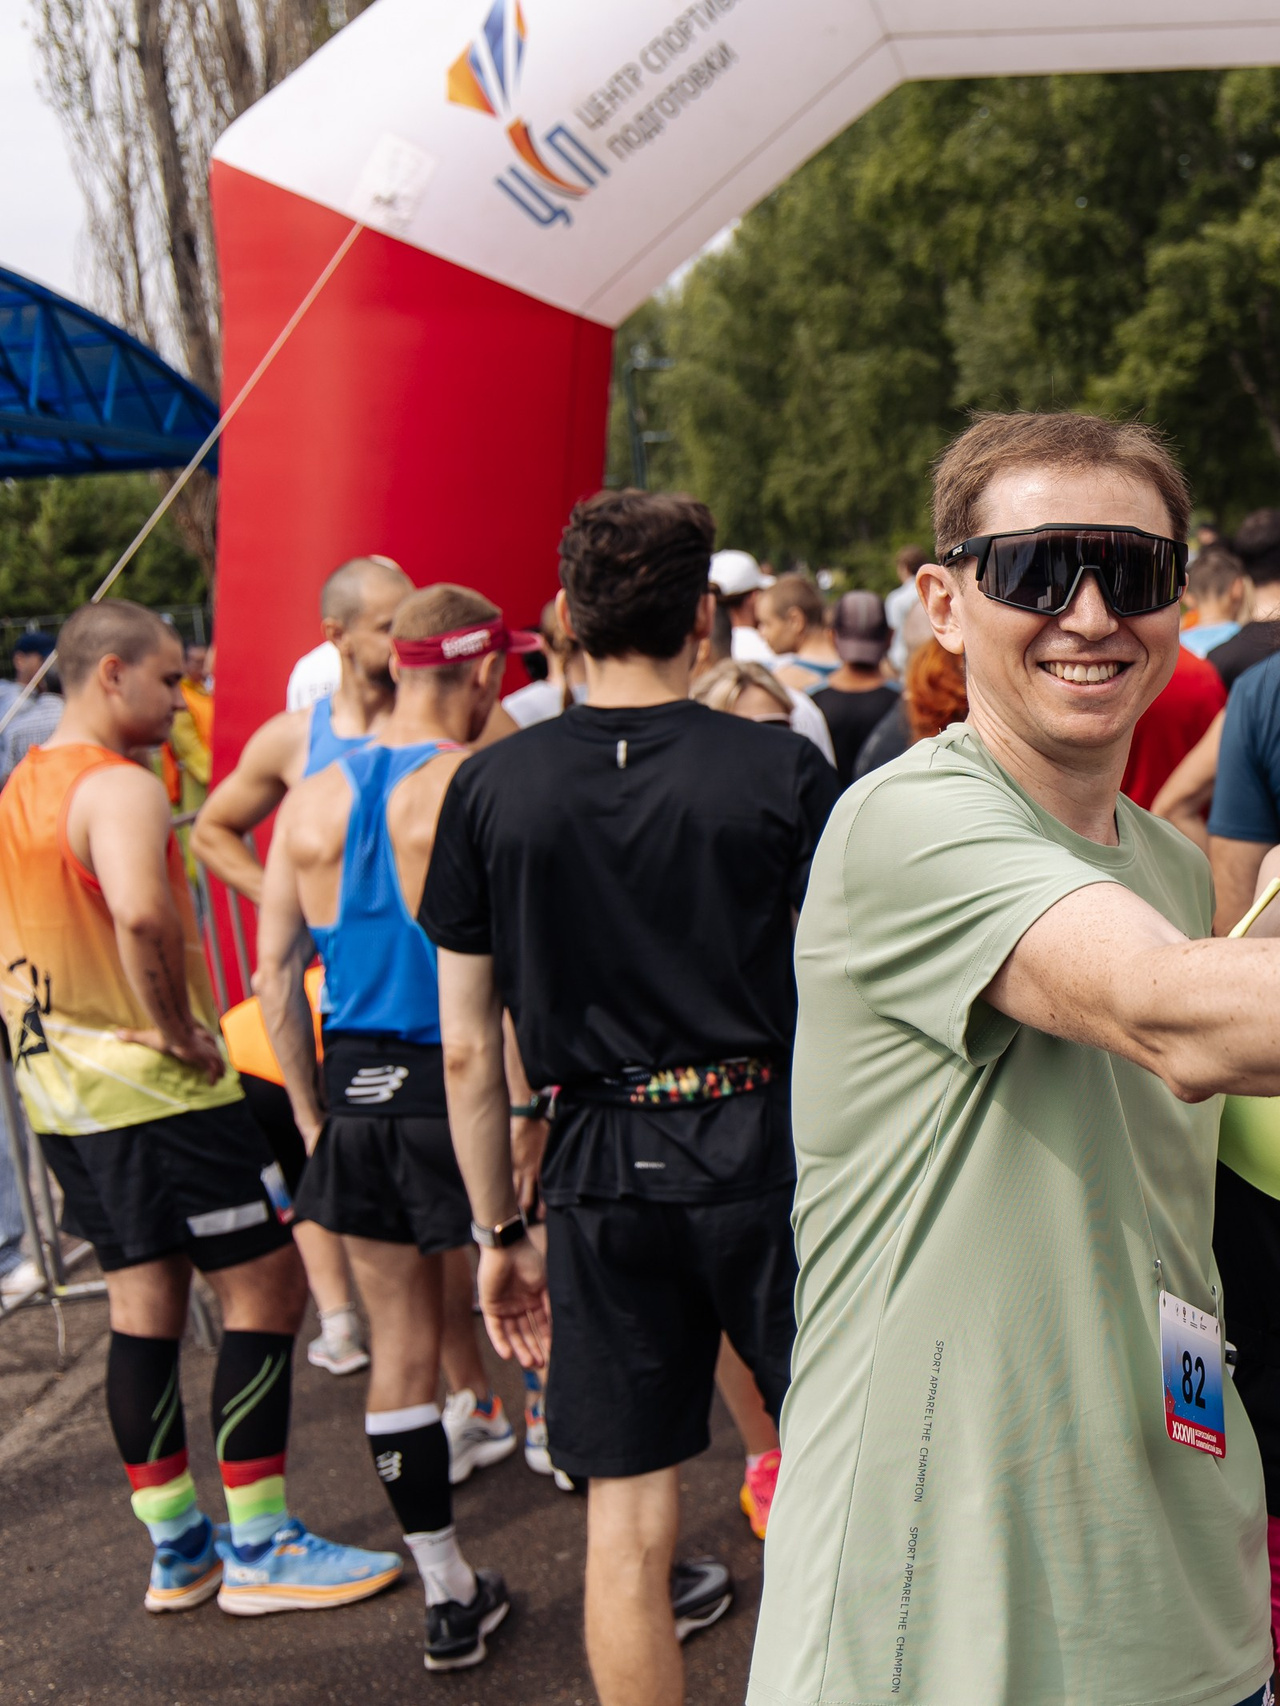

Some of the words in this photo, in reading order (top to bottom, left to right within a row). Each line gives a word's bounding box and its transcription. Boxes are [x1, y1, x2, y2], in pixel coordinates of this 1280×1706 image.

[574, 63, 643, 131] ЦЕНТР
[606, 41, 738, 161] ПОДГОТОВКИ
[932, 1340, 945, 1373] SPORT
[1182, 1350, 1206, 1410] 82
[924, 1375, 938, 1420] APPAREL
[921, 1422, 933, 1442] THE
[914, 1447, 929, 1502] CHAMPION
[906, 1527, 919, 1560] SPORT
[900, 1562, 914, 1609] APPAREL
[897, 1610, 909, 1630] THE
[891, 1636, 905, 1693] CHAMPION
